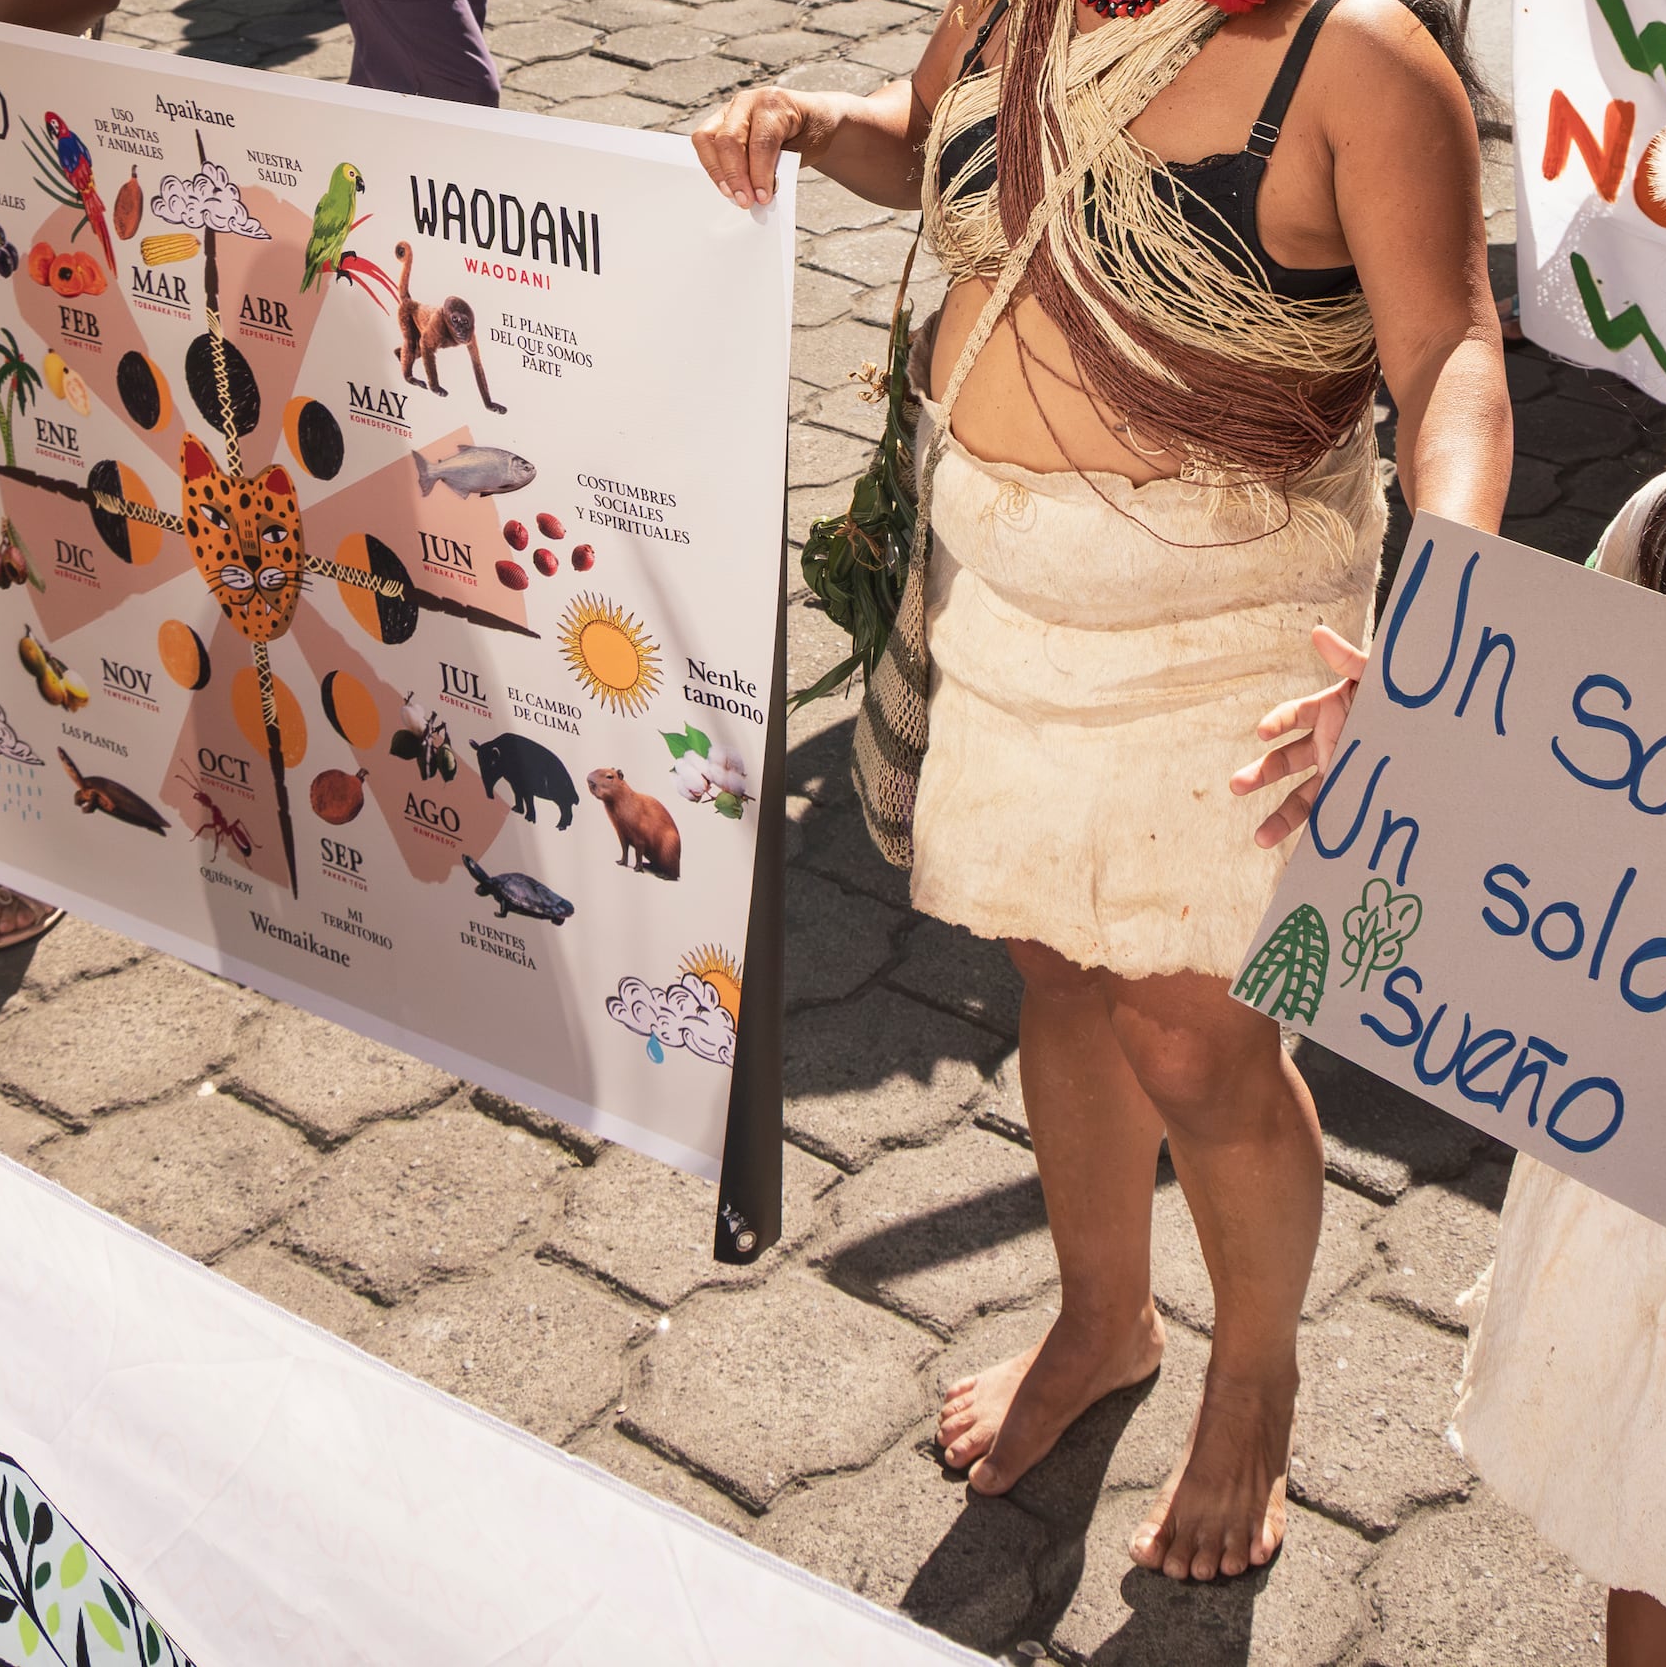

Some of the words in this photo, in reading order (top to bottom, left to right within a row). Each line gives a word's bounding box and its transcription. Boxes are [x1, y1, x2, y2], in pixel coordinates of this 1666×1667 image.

[111, 107, 134, 122] USO
[155, 94, 236, 128] Apaikane
[94, 119, 110, 132] DE
[111, 122, 160, 143] PLANTAS
[96, 134, 106, 147] Y
[107, 137, 164, 160] ANIMALES
[247, 150, 303, 173] NUESTRA
[257, 168, 298, 187] SALUD
[410, 175, 601, 276] WAODANI
[132, 266, 191, 305] MAR
[464, 256, 551, 290] WAODANI
[58, 305, 101, 338] FEB
[239, 293, 293, 331] ABR
[502, 313, 517, 329] EL
[519, 317, 578, 346] PLANETA
[490, 328, 515, 347] DEL
[517, 335, 545, 356] QUE
[546, 343, 593, 368] SOMOS
[522, 354, 562, 378] PARTE
[347, 381, 408, 420] MAY
[35, 417, 80, 452] ENE
[394, 425, 413, 439] TEDE
[577, 473, 677, 508] COSTUMBRES
[593, 493, 664, 522] SOCIALES
[575, 506, 585, 520] Y
[589, 509, 691, 545] ESPIRITUALES
[55, 539, 95, 573] DIC
[418, 531, 473, 570] JUN
[458, 574, 478, 587] TEDE
[1381, 538, 1517, 737] Un
[100, 657, 152, 695] NOV
[438, 661, 487, 701] JUL
[685, 657, 757, 699] Nenke
[472, 705, 493, 719] TEDE
[507, 687, 523, 702] EL
[525, 693, 582, 720] CAMBIO
[513, 705, 532, 721] DE
[533, 711, 581, 736] CLIMA
[682, 684, 764, 725] tamono
[61, 723, 81, 740] LAS
[82, 730, 129, 758] PLANTAS
[198, 748, 250, 783] OCT
[404, 791, 461, 833] AGO
[1307, 739, 1420, 886] Un
[320, 837, 363, 873] SEP
[199, 866, 233, 886] QUIÉN
[234, 879, 253, 895] SOY
[320, 911, 393, 950] TERRITORIO
[347, 907, 363, 923] MI
[249, 911, 351, 967] Wemaikane
[460, 932, 478, 948] DE
[481, 937, 537, 971] ENERGÍA
[469, 920, 526, 951] FUENTES
